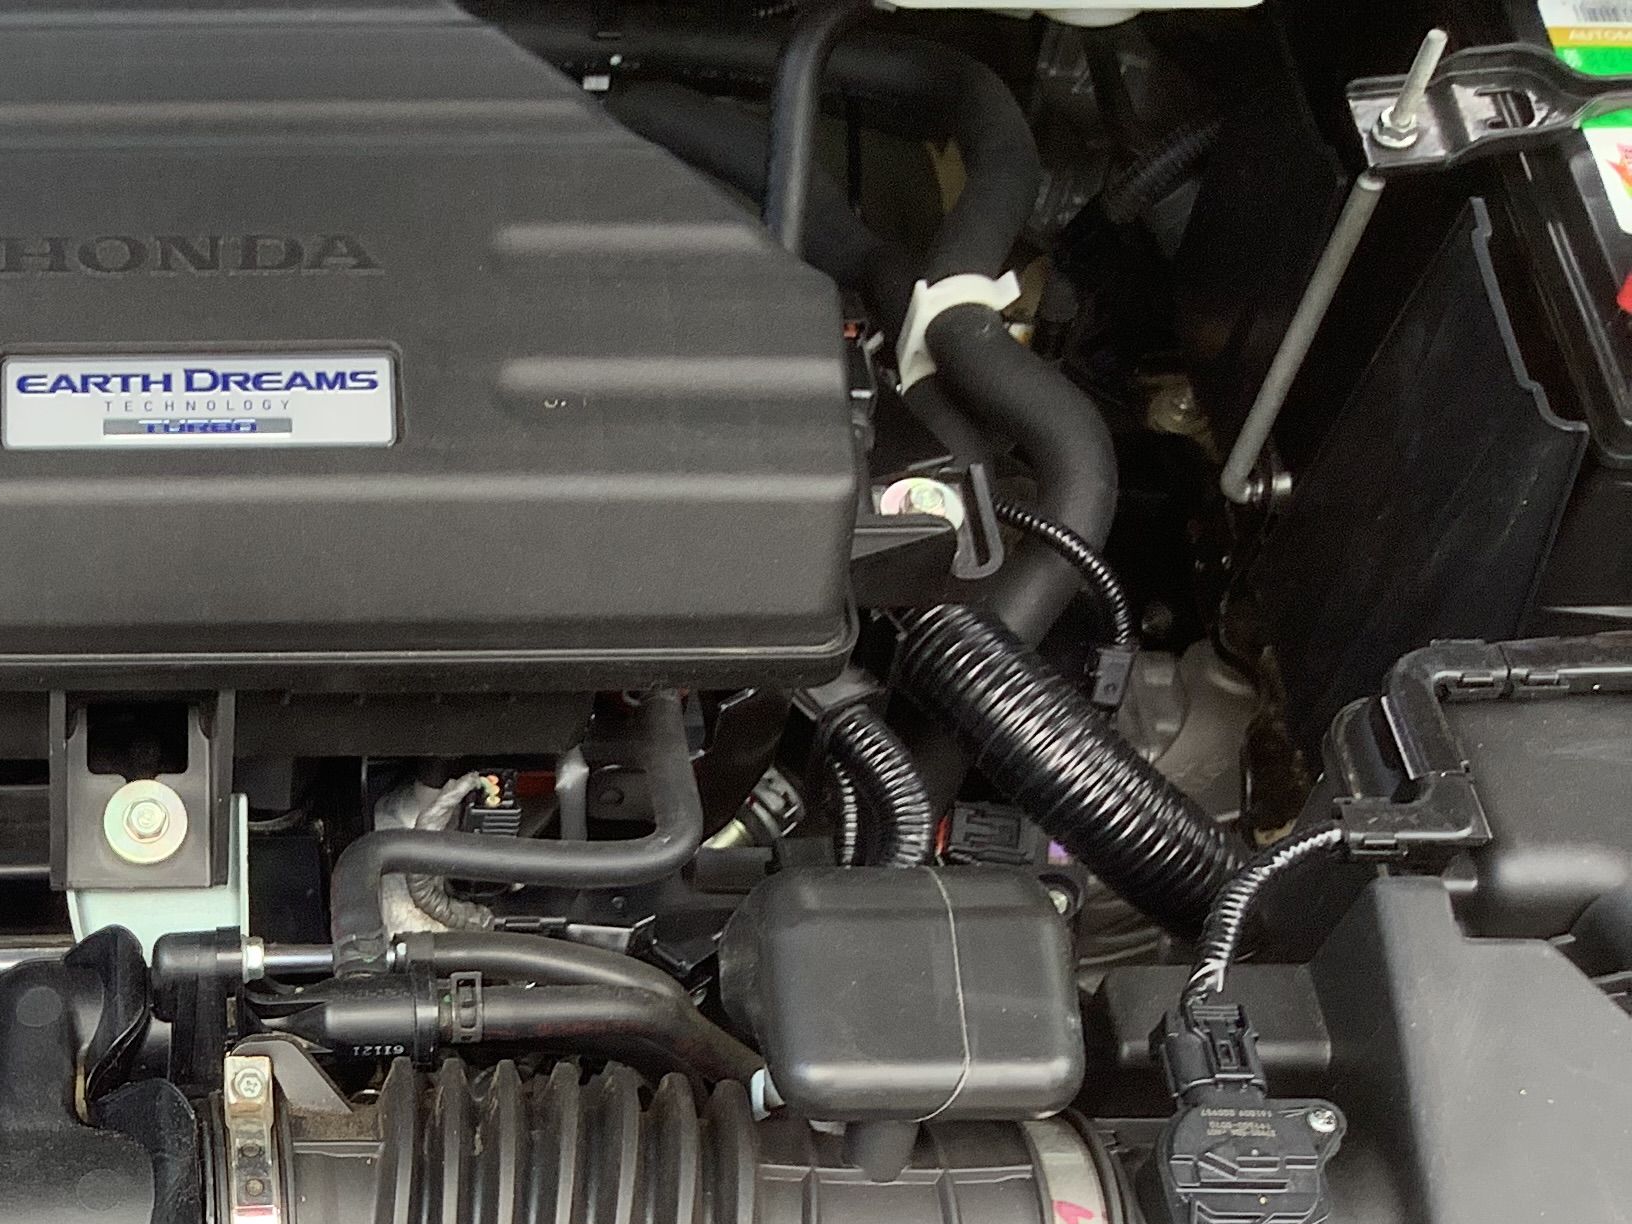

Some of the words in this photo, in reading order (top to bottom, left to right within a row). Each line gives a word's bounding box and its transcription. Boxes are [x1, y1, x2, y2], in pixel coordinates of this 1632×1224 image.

[16, 371, 173, 394] EARTH
[183, 368, 379, 393] DREAMS
[105, 400, 290, 412] TECHNOLOGY
[138, 418, 257, 434] TURBO
[353, 1045, 405, 1056] 61121
